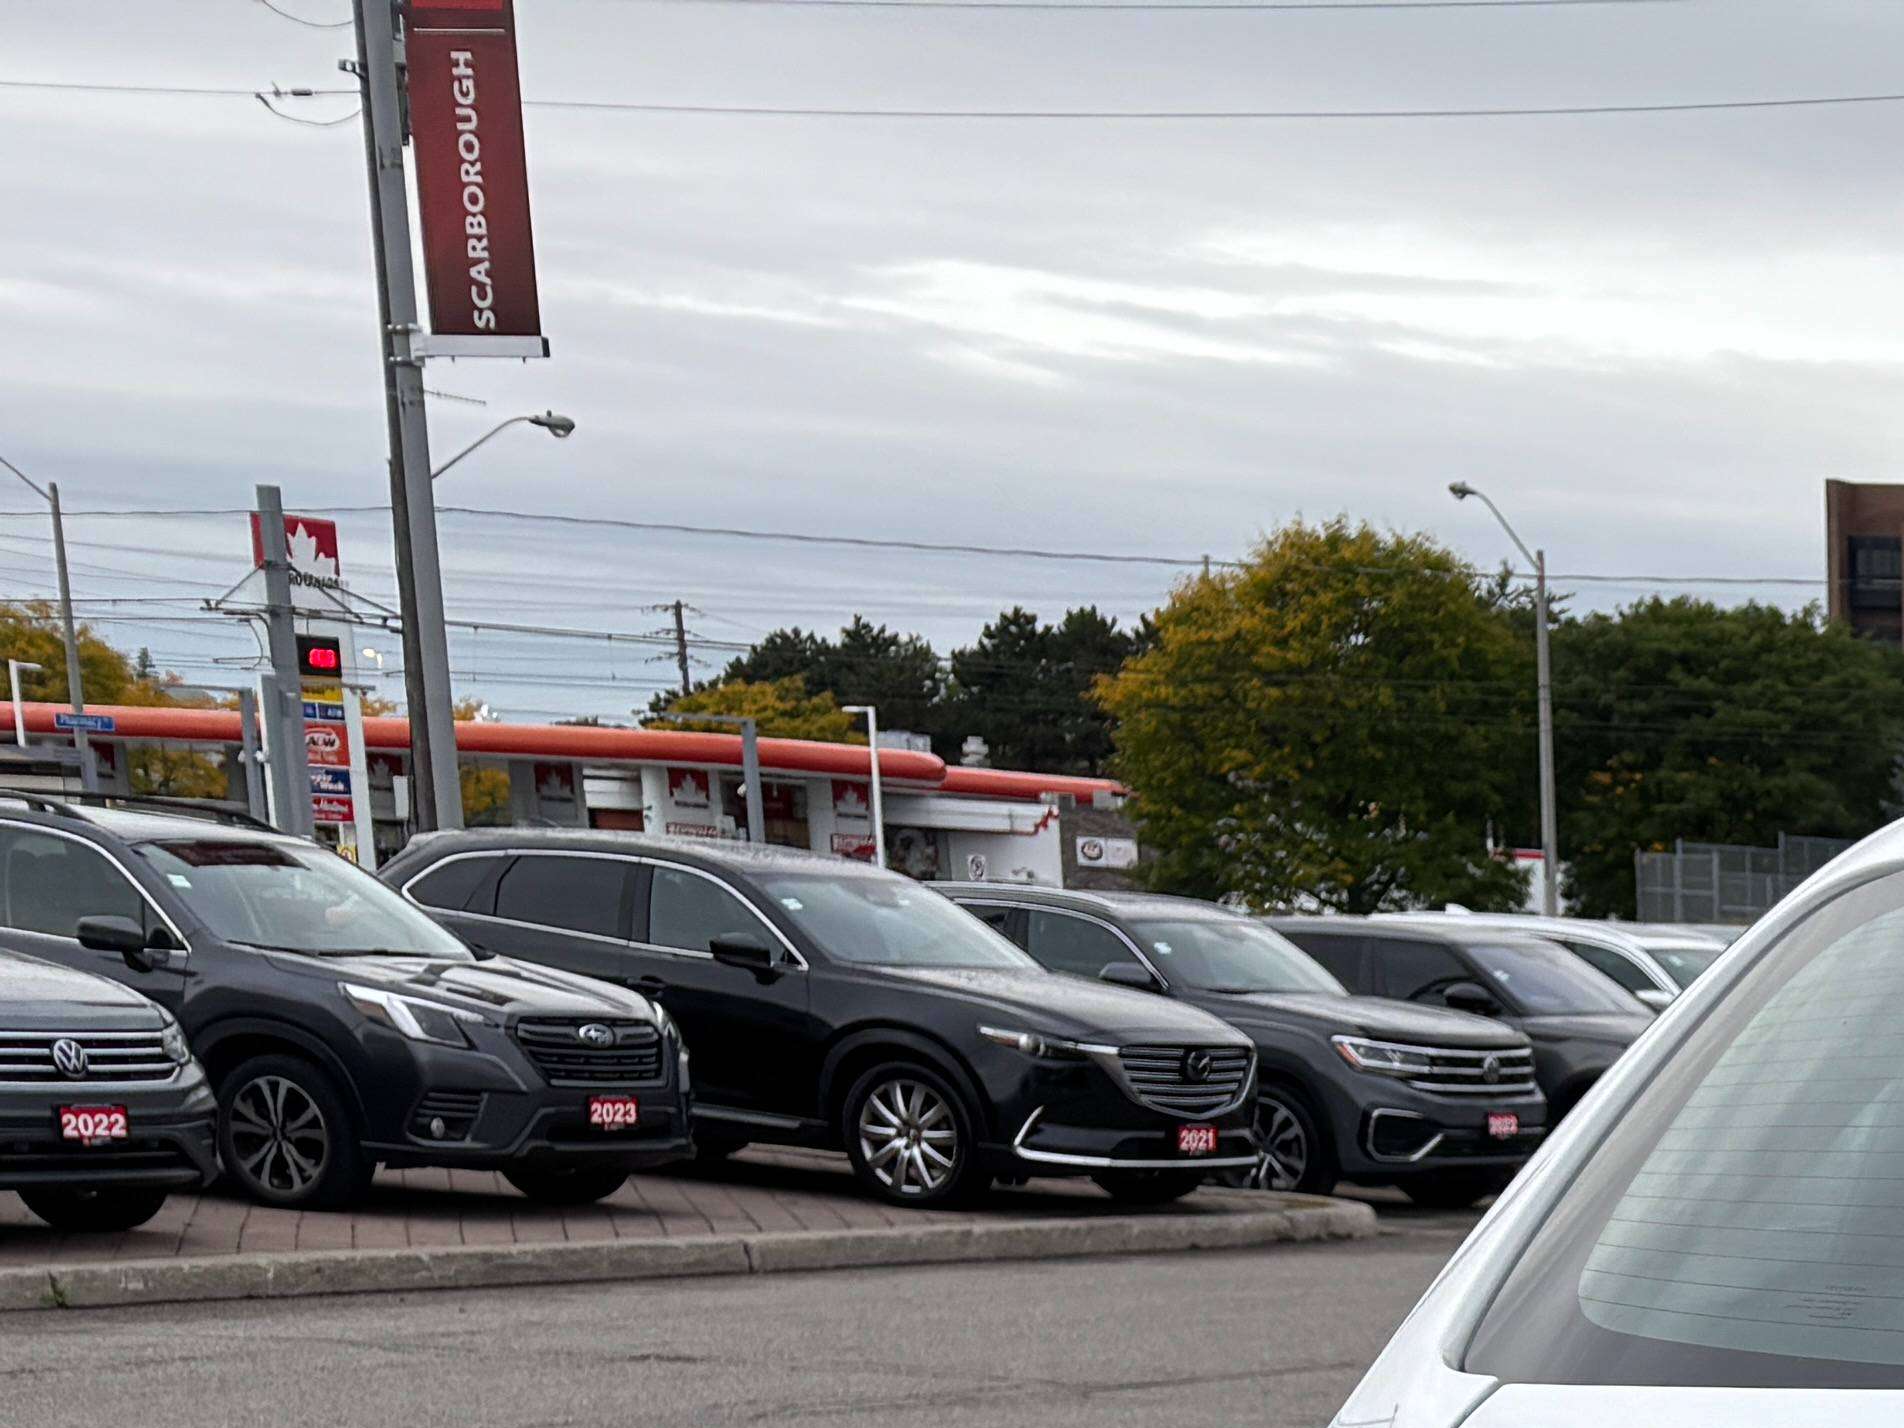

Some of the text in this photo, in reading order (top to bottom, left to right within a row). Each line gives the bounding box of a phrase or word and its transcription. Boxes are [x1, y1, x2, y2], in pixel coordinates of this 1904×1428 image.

[450, 49, 496, 331] SCARBOROUGH
[591, 1102, 637, 1123] 2023
[61, 1112, 127, 1137] 2022
[1180, 1129, 1214, 1150] 2021
